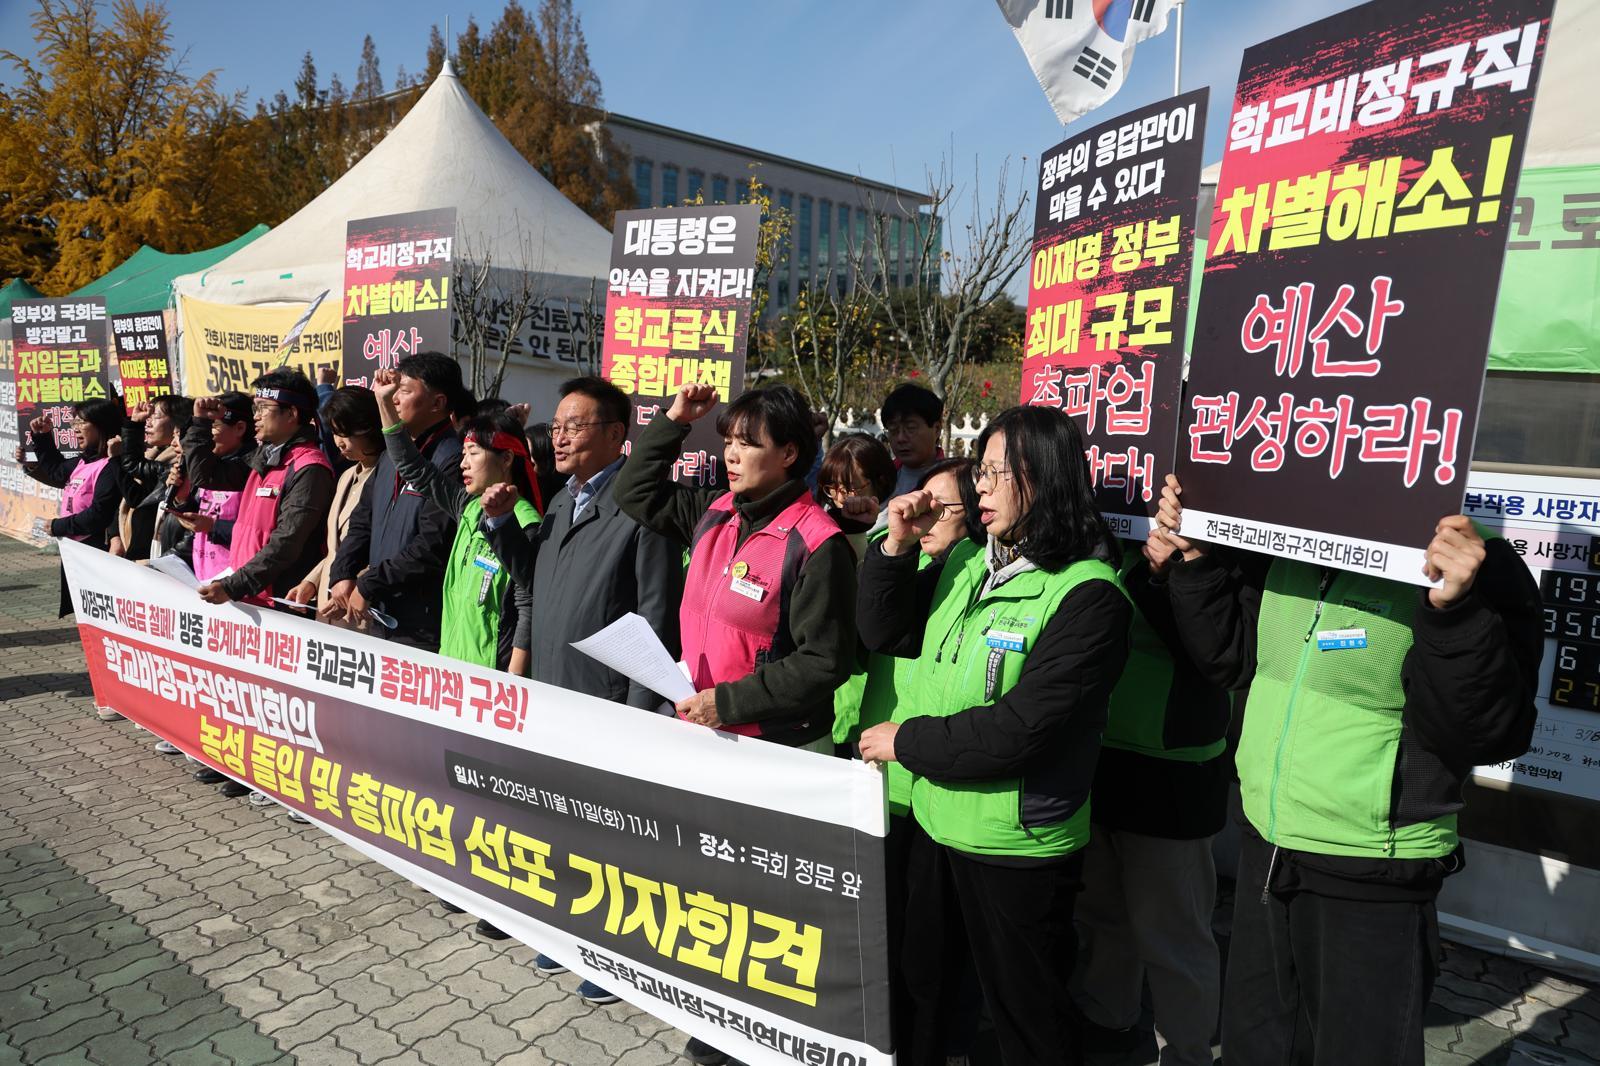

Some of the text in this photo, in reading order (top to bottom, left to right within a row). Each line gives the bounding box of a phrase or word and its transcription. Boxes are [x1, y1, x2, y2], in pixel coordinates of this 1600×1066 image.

[1229, 21, 1541, 154] 학교비정규직
[1041, 103, 1196, 191] 정부의 응답만이
[1049, 158, 1166, 223] 막을 수 있다
[1212, 134, 1514, 256] 차별해소!
[346, 236, 453, 272] 학교비정규직
[623, 214, 737, 257] 대통령은
[1033, 214, 1181, 291] 이재명 정부
[346, 276, 450, 317] 차별해소!
[608, 267, 755, 298] 약속을 지켜라!
[12, 303, 107, 324] 정부와 국회는
[113, 315, 163, 334] 정부의 응답만이
[613, 306, 737, 354] 학교급식
[1026, 285, 1174, 359] 최대 규모
[1241, 275, 1404, 378] 예산
[25, 326, 88, 345] 방관말고
[136, 338, 143, 349] 수
[144, 335, 159, 350] 있다
[204, 327, 228, 349] 간호사
[228, 332, 279, 353] 진료지원업무
[528, 335, 551, 359] 안
[18, 349, 102, 375] 저임금과
[120, 358, 168, 379] 이재명 정부
[206, 353, 249, 394] 56만
[608, 353, 732, 403] 종합대책
[17, 376, 106, 403] 차별해소
[1188, 391, 1464, 488] 편성하라!
[1464, 493, 1600, 522] 부작용 사망자
[1205, 519, 1389, 573] 전국학교비정규직연대회의
[1534, 541, 1590, 562] 사망자
[80, 588, 529, 733] 비정규직 저임금 철폐! 방중 생계대책 마련! 학교급식 종합대책 구성!
[102, 636, 325, 754] 학교비정규직연대회의
[489, 776, 540, 806] 2025년
[539, 789, 569, 815] 11월
[569, 798, 625, 831] 11일(화)
[627, 814, 660, 841] 11시
[750, 846, 789, 879] 국회
[794, 857, 836, 892] 정문
[841, 870, 863, 899] 앞
[199, 714, 823, 1007] 농성 돌입 및 총파업 선포 기자회견
